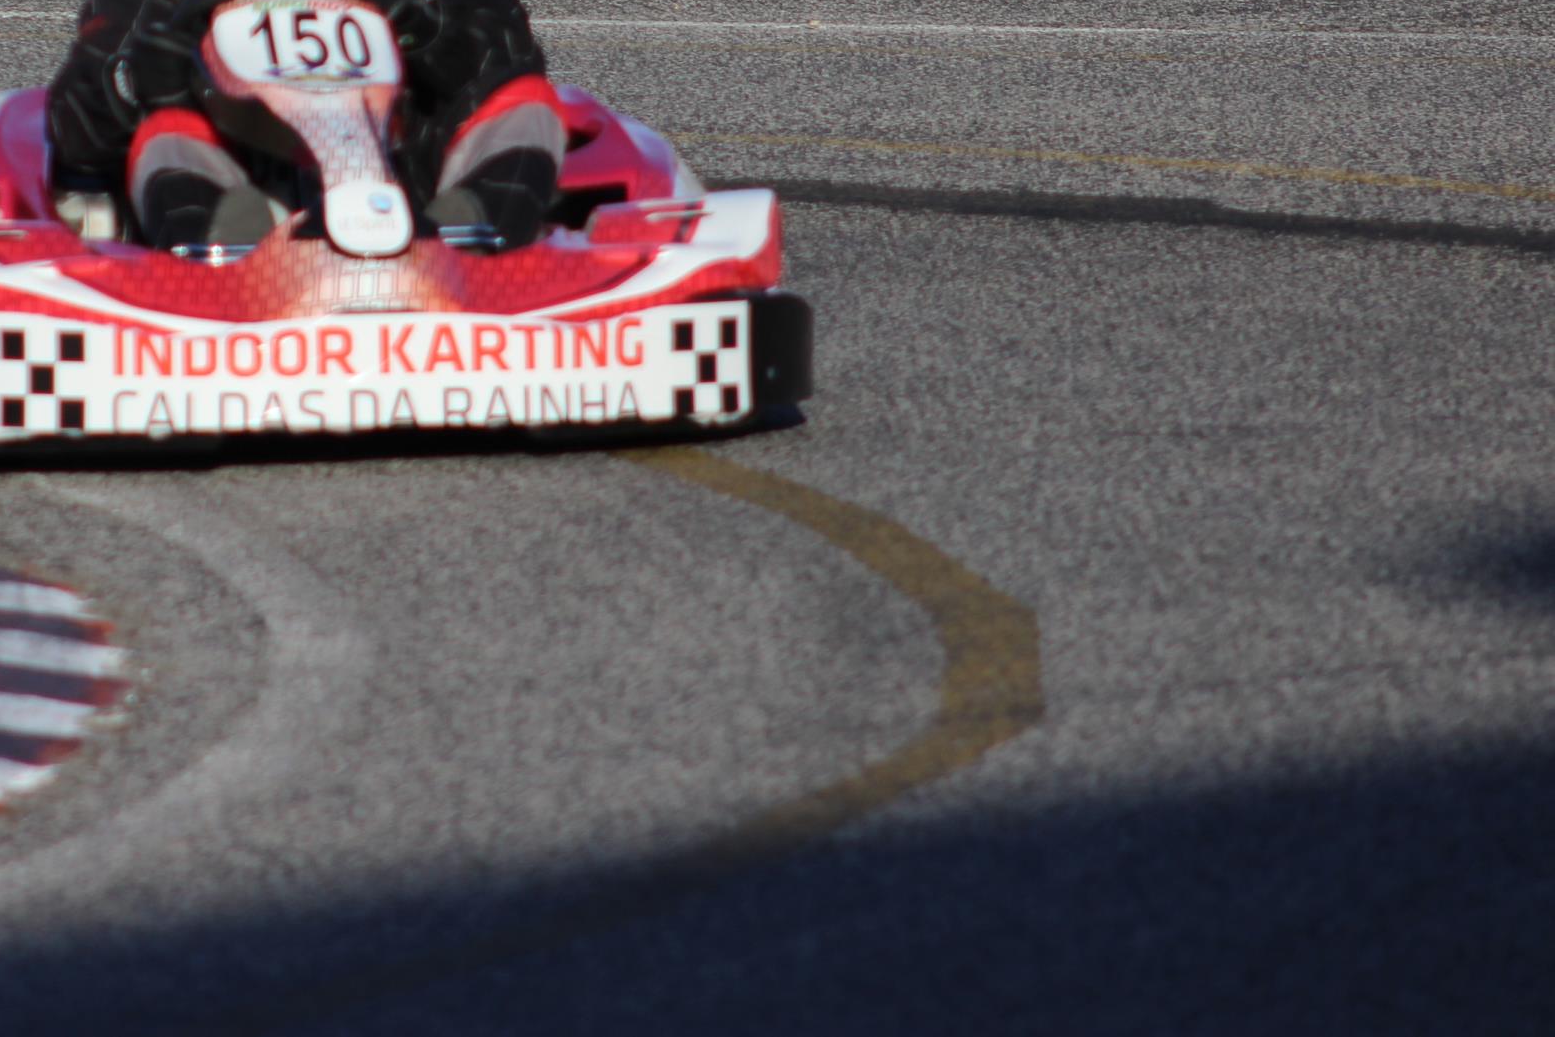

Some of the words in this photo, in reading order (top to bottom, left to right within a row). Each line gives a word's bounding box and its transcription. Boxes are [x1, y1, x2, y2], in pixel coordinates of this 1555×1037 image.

[250, 10, 371, 69] 150
[112, 325, 357, 377] INDOOR
[378, 317, 644, 375] KARTING
[112, 390, 329, 434] CALDAS
[349, 388, 418, 431] DA
[443, 381, 638, 428] RAINHA
